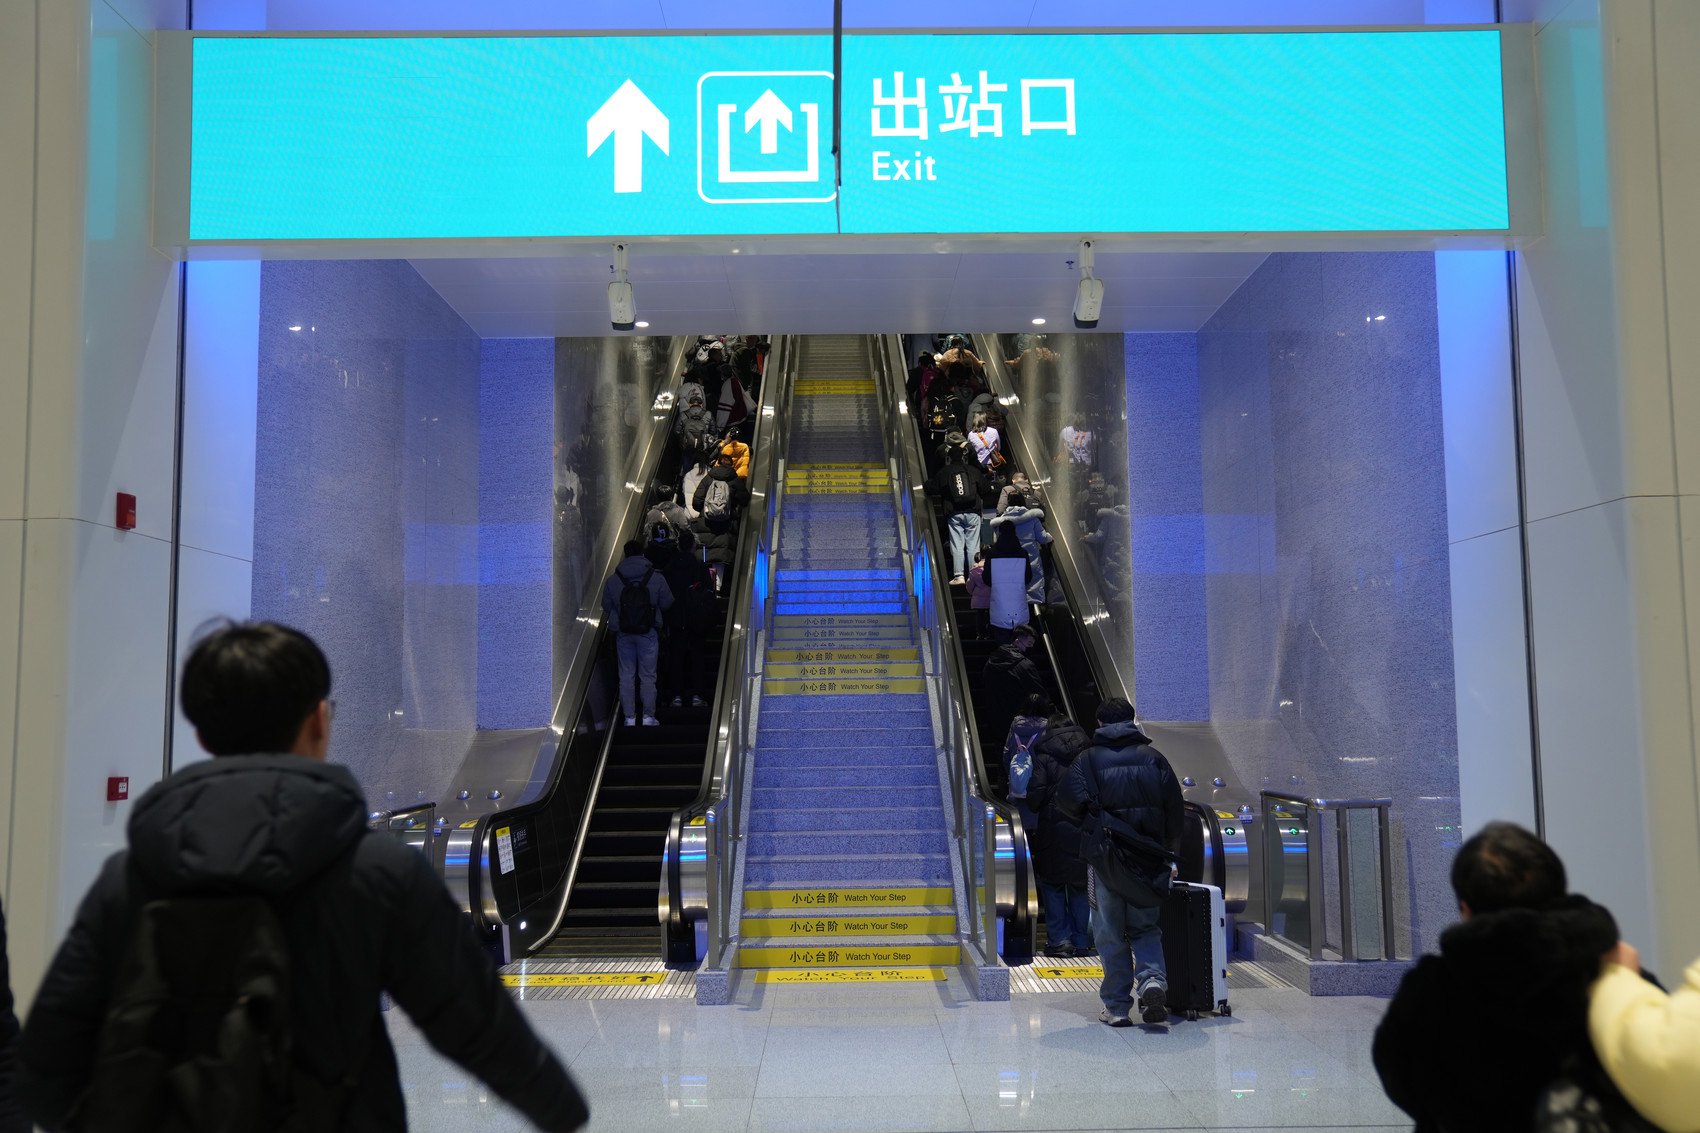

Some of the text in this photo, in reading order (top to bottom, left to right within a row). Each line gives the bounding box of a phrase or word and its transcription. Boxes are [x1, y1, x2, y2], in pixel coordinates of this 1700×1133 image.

[871, 70, 1077, 140] 出站口
[872, 150, 937, 181] Exit
[796, 652, 832, 660] 小心台阶
[800, 666, 836, 676] 小心台阶
[800, 682, 836, 692] 小心台阶
[792, 892, 838, 904] 小心台阶
[888, 894, 906, 902] Step
[790, 920, 838, 932] 小心台阶
[890, 922, 908, 930] Step
[790, 950, 839, 962] 小心台阶
[893, 952, 911, 962] Step
